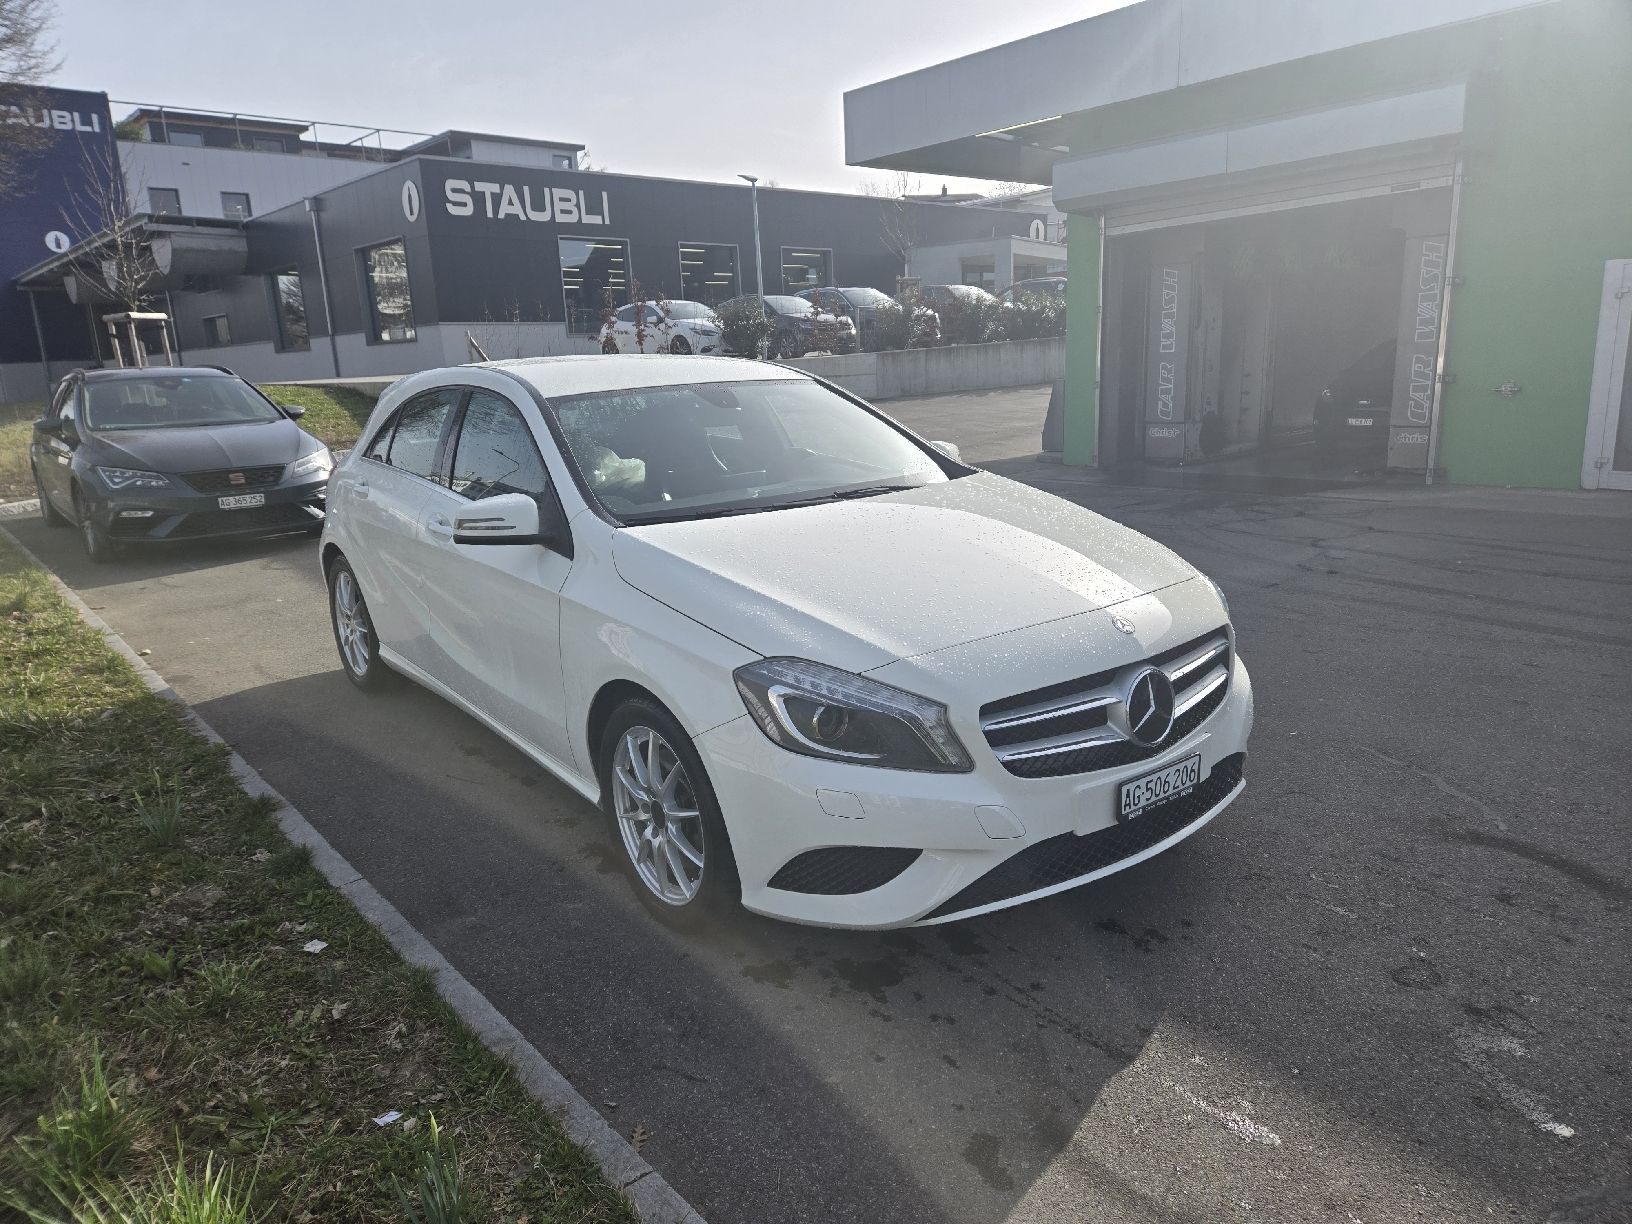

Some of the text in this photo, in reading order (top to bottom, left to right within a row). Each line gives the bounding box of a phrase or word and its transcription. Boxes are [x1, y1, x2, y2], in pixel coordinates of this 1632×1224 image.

[444, 178, 610, 225] STAUBLI
[1157, 268, 1178, 420] CAR WASH
[1407, 241, 1445, 424] CAR WASH
